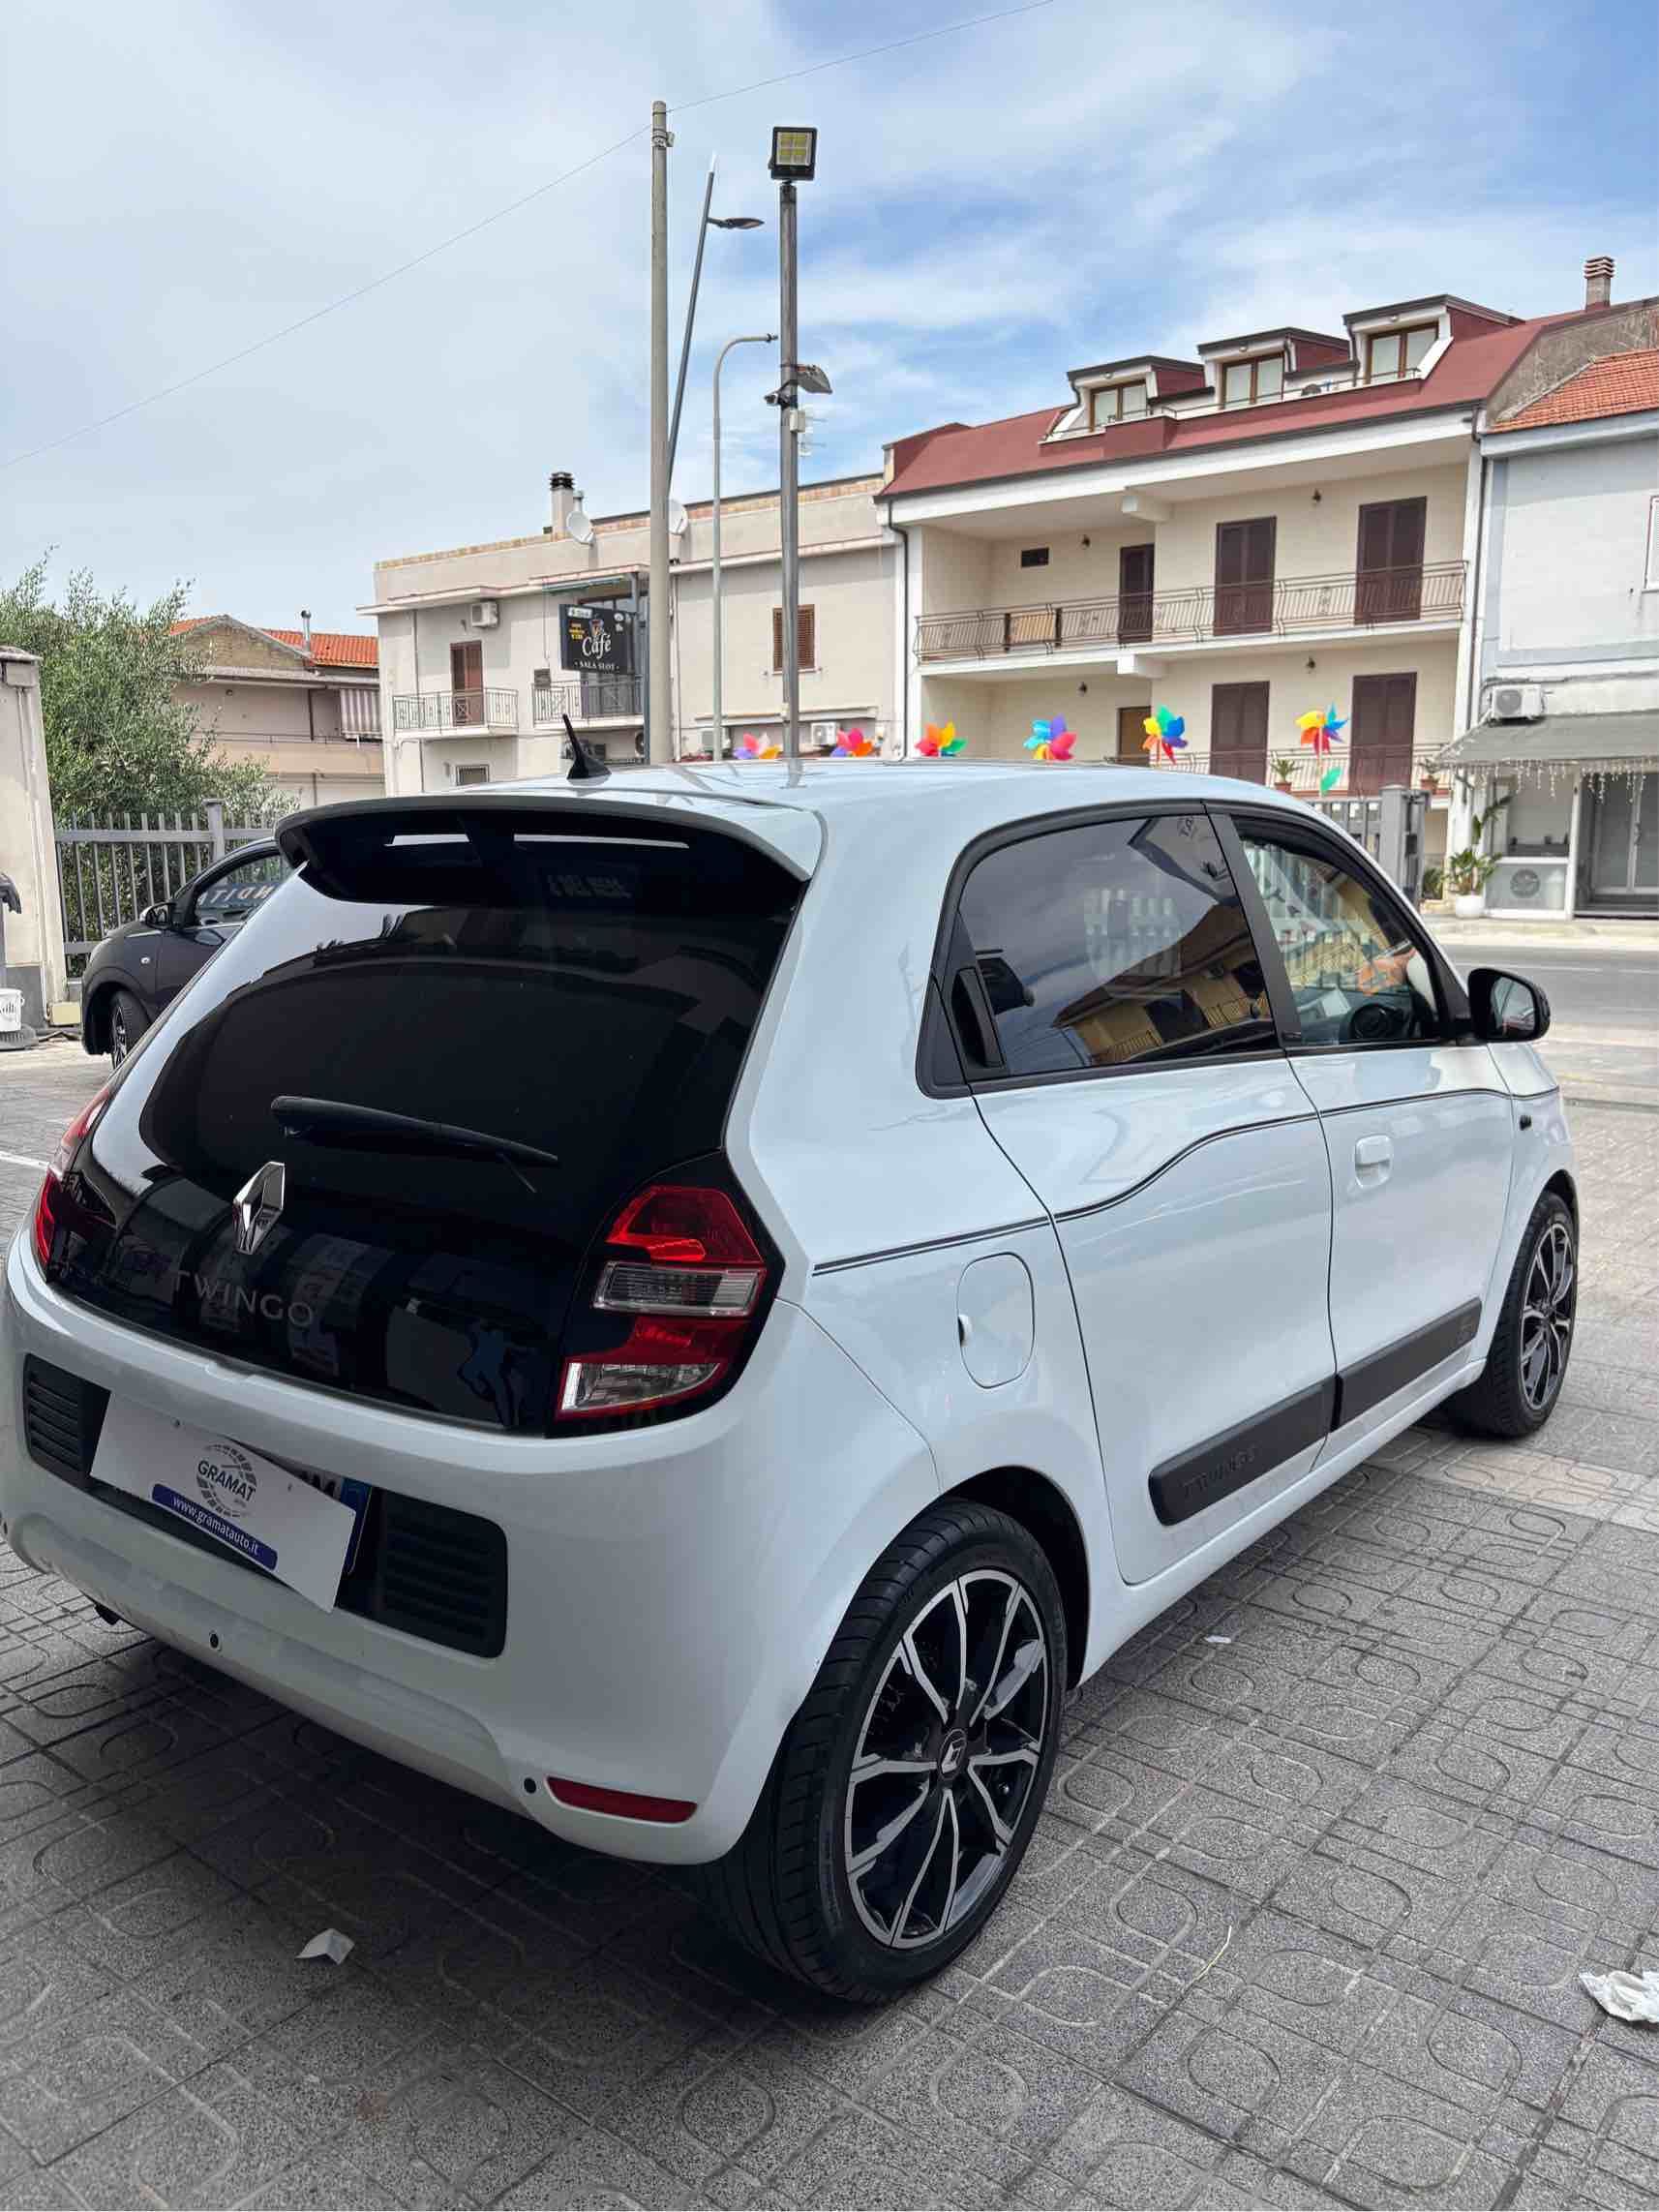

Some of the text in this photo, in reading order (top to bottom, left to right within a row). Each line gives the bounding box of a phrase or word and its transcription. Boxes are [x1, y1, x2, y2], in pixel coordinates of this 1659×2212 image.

[582, 634, 612, 659] Café
[171, 1270, 314, 1326] TWINGO
[196, 1459, 256, 1501] GRAMAT
[171, 1496, 259, 1556] www.gramatauto.it
